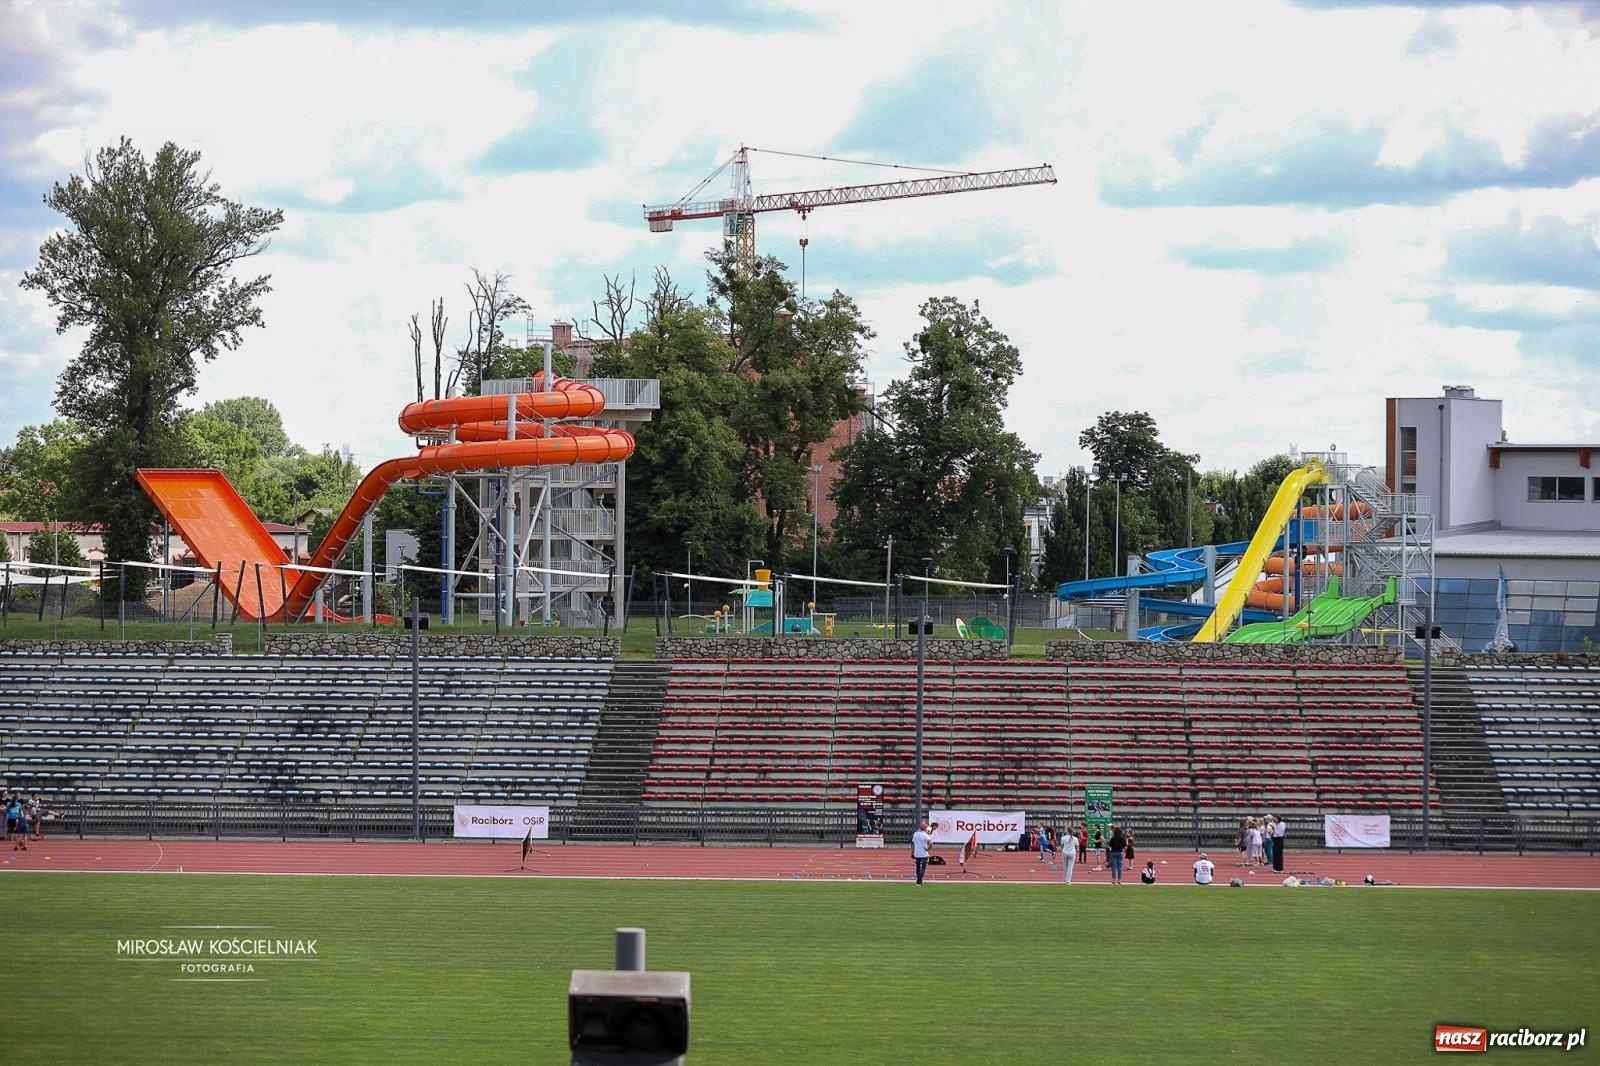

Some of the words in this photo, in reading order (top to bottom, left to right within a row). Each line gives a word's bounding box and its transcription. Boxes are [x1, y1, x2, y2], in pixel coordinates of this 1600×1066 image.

[471, 816, 514, 825] Racibórz
[522, 816, 545, 825] OSiR
[956, 820, 1018, 832] Racibórz
